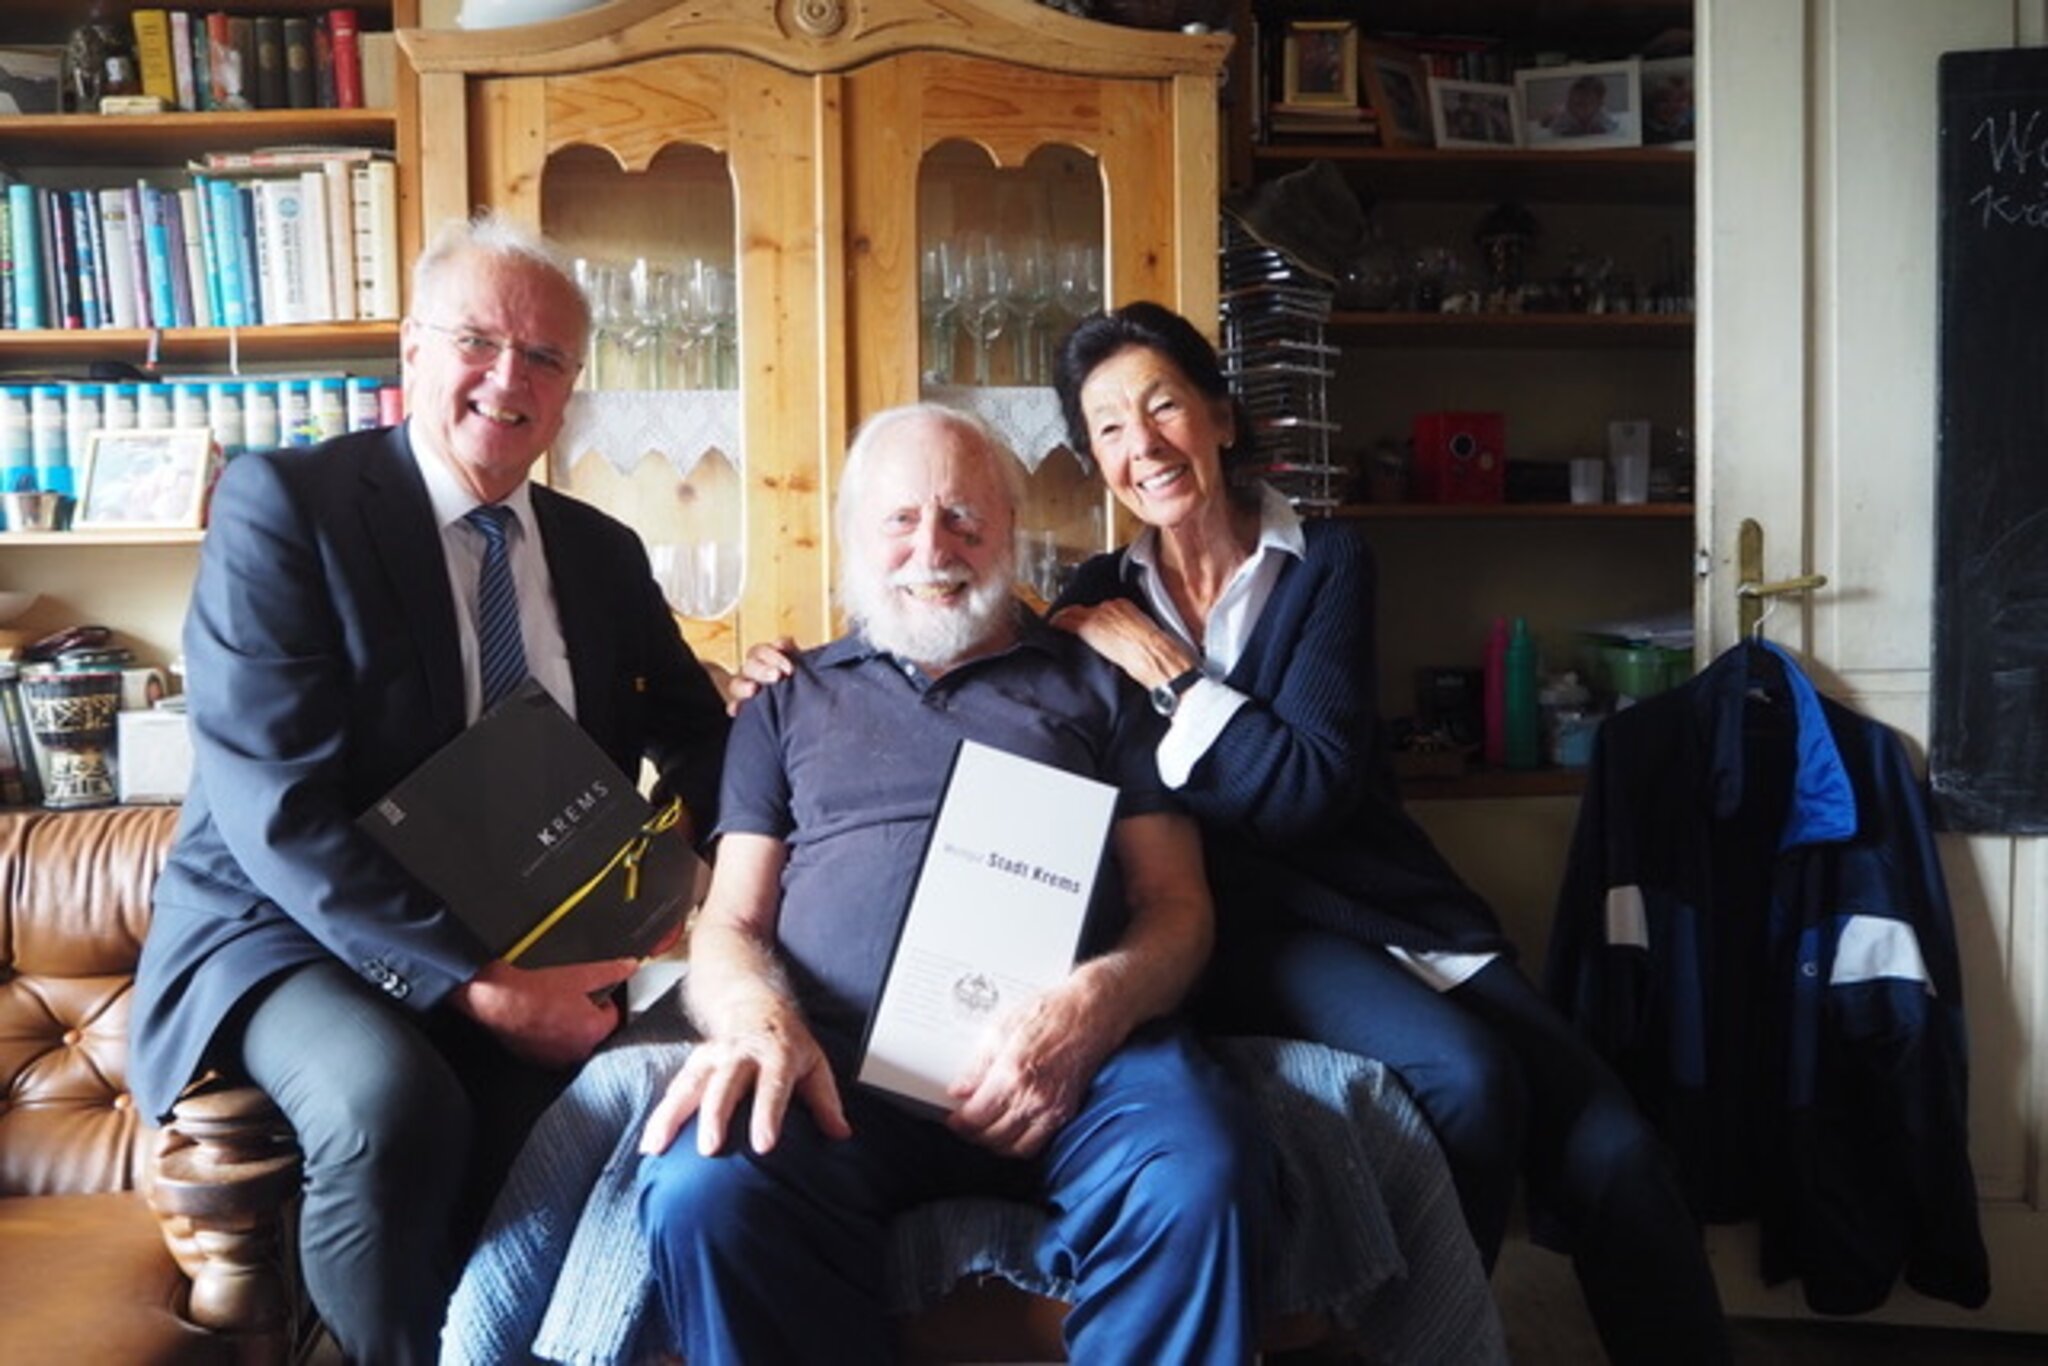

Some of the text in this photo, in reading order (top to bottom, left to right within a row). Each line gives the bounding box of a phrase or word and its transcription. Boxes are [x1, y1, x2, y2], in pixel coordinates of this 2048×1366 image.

[537, 780, 609, 847] KREMS
[986, 852, 1030, 878] Stadt
[1031, 866, 1081, 894] Krems
